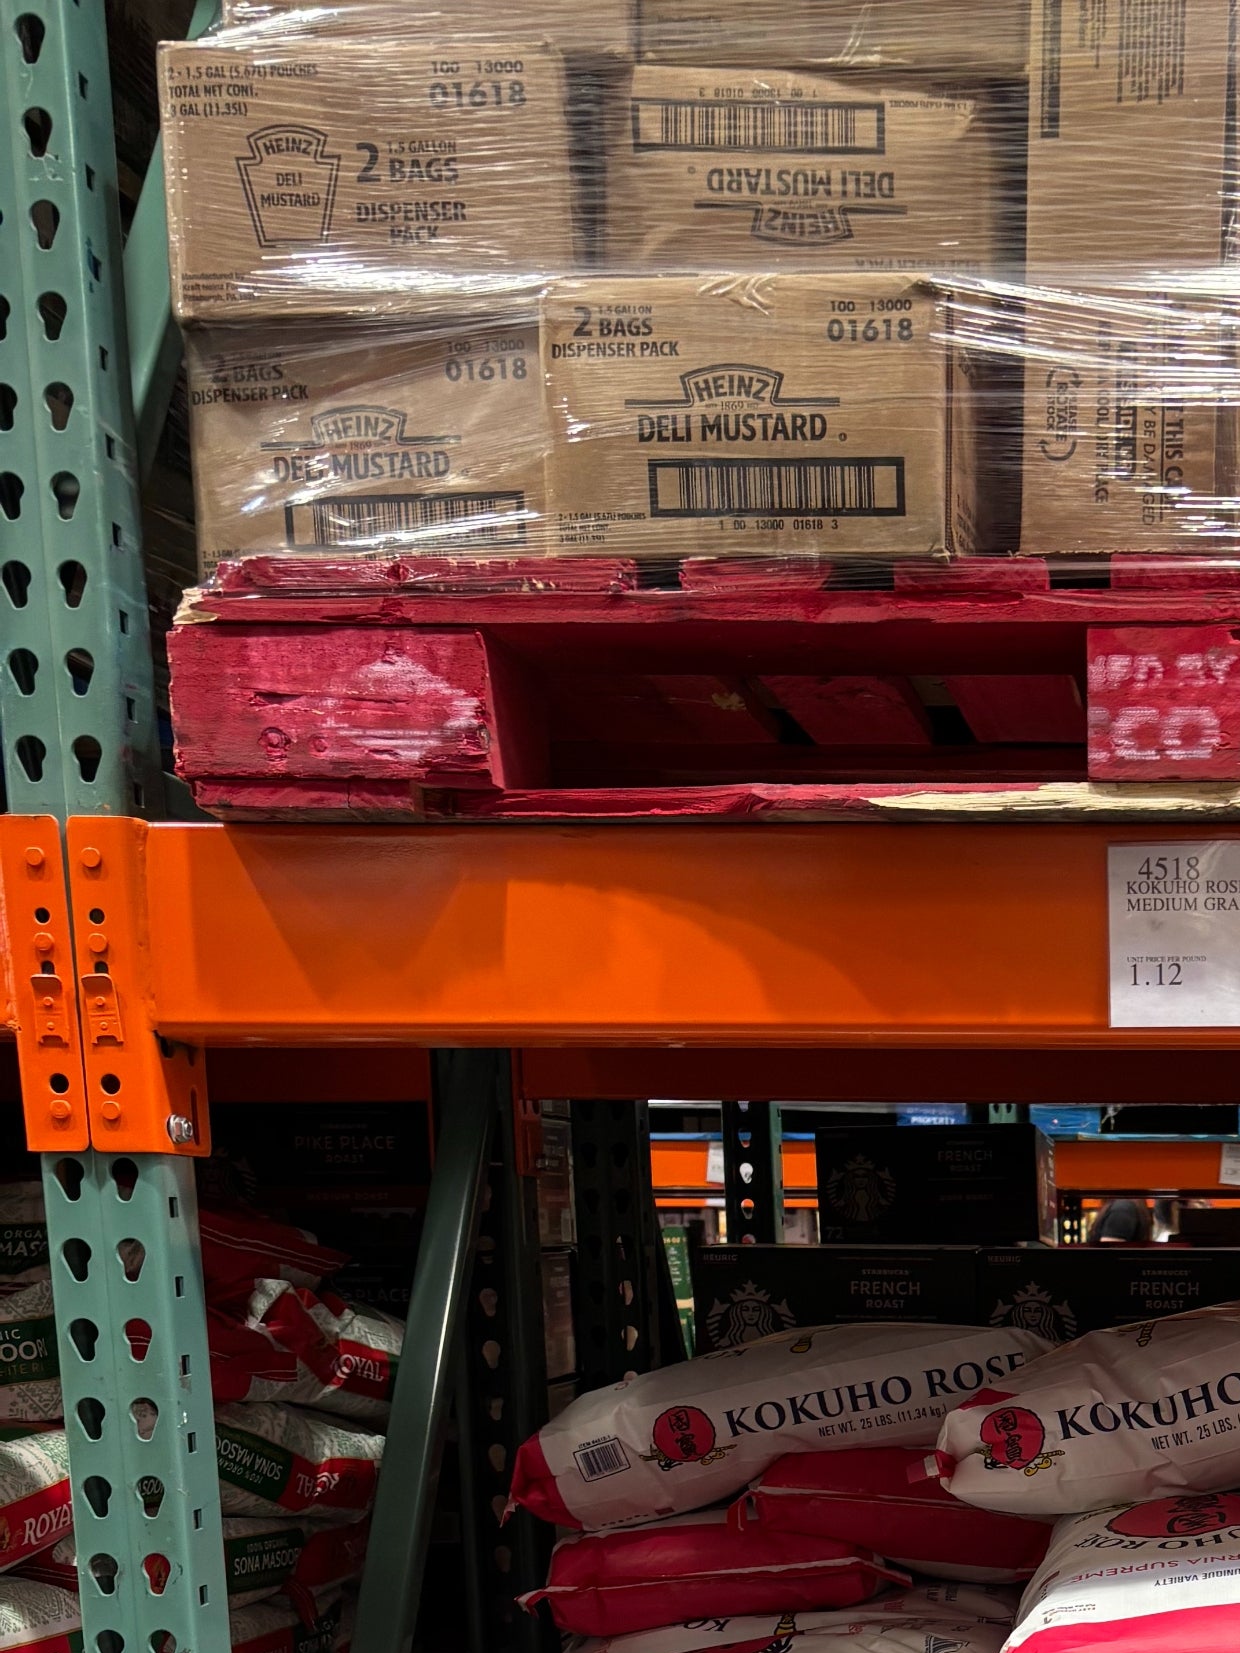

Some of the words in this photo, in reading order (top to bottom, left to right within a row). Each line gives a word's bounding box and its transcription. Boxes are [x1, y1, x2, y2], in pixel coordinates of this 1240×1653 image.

[169, 84, 200, 98] TOTAL
[204, 84, 222, 97] NET
[429, 82, 527, 107] 01618
[262, 135, 314, 156] HEINZ
[276, 172, 303, 187] DELI
[389, 158, 459, 184] BAGS
[707, 169, 832, 197] MUSTARD
[842, 171, 895, 198] DELI
[260, 192, 321, 208] MUSTARD
[356, 202, 466, 223] DISPENSER
[615, 306, 652, 314] GALLON
[830, 300, 855, 313] 100
[870, 300, 912, 312] 13000
[573, 307, 593, 336] 2
[600, 318, 653, 337] BAGS
[827, 318, 913, 342] 01618
[551, 342, 636, 360] DISPENSER
[640, 341, 679, 357] PACK
[446, 358, 527, 382] 01618
[192, 386, 268, 405] DISPENSER
[271, 384, 308, 401] PACK
[693, 375, 769, 402] HEINZ
[720, 400, 744, 411] 1869
[638, 415, 691, 443] DELI
[701, 413, 827, 442] MUSTARD
[1138, 856, 1200, 881] 4518
[1126, 880, 1200, 895] KOKUHO
[1126, 898, 1198, 912] MEDIUM
[1129, 963, 1183, 986] 1.12
[850, 1282, 921, 1295] FRENCH
[866, 1299, 904, 1309] ROAST
[1155, 1574, 1199, 1587] VARIETY
[1202, 1568, 1240, 1580] UNIQUE
